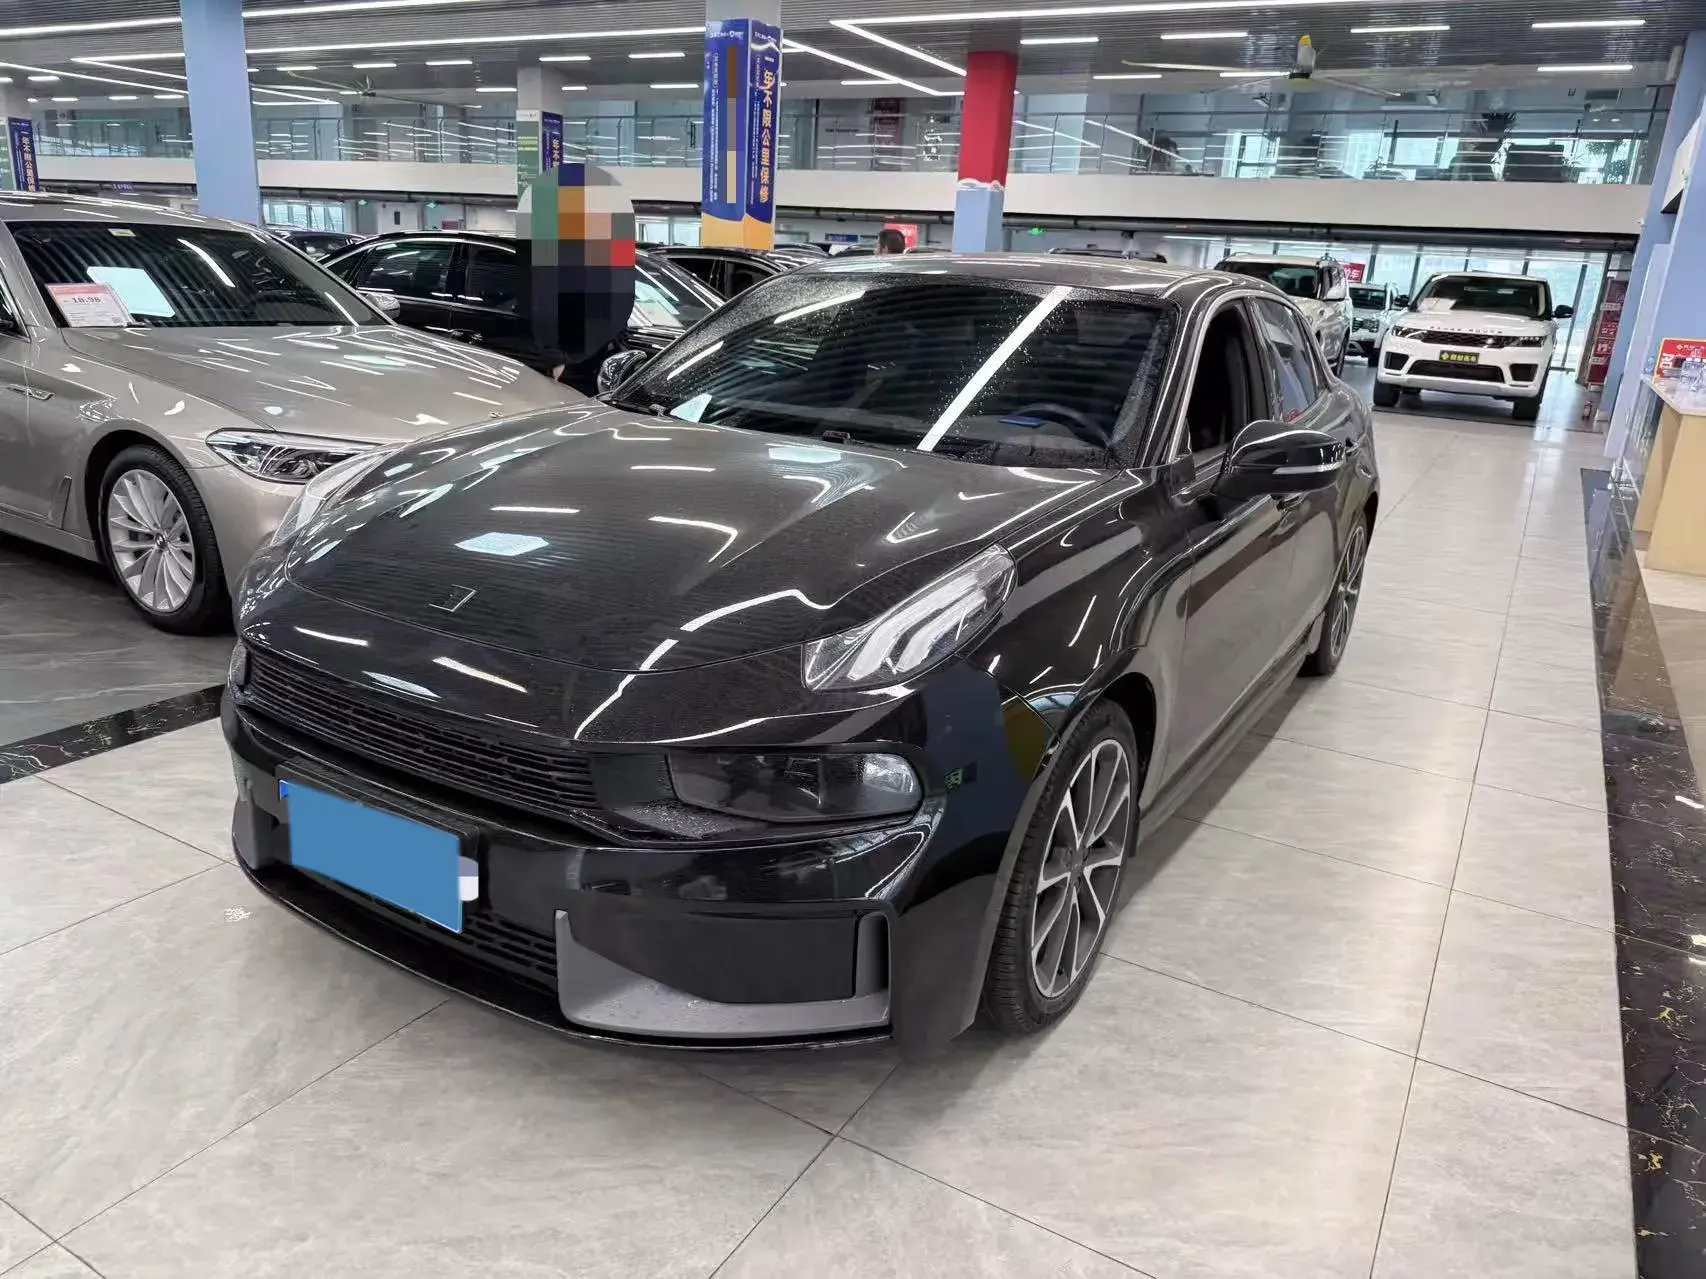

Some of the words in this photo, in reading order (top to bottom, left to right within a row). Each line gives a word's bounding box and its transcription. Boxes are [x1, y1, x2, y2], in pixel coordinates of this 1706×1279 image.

[760, 56, 775, 203] 一年不限公里保修
